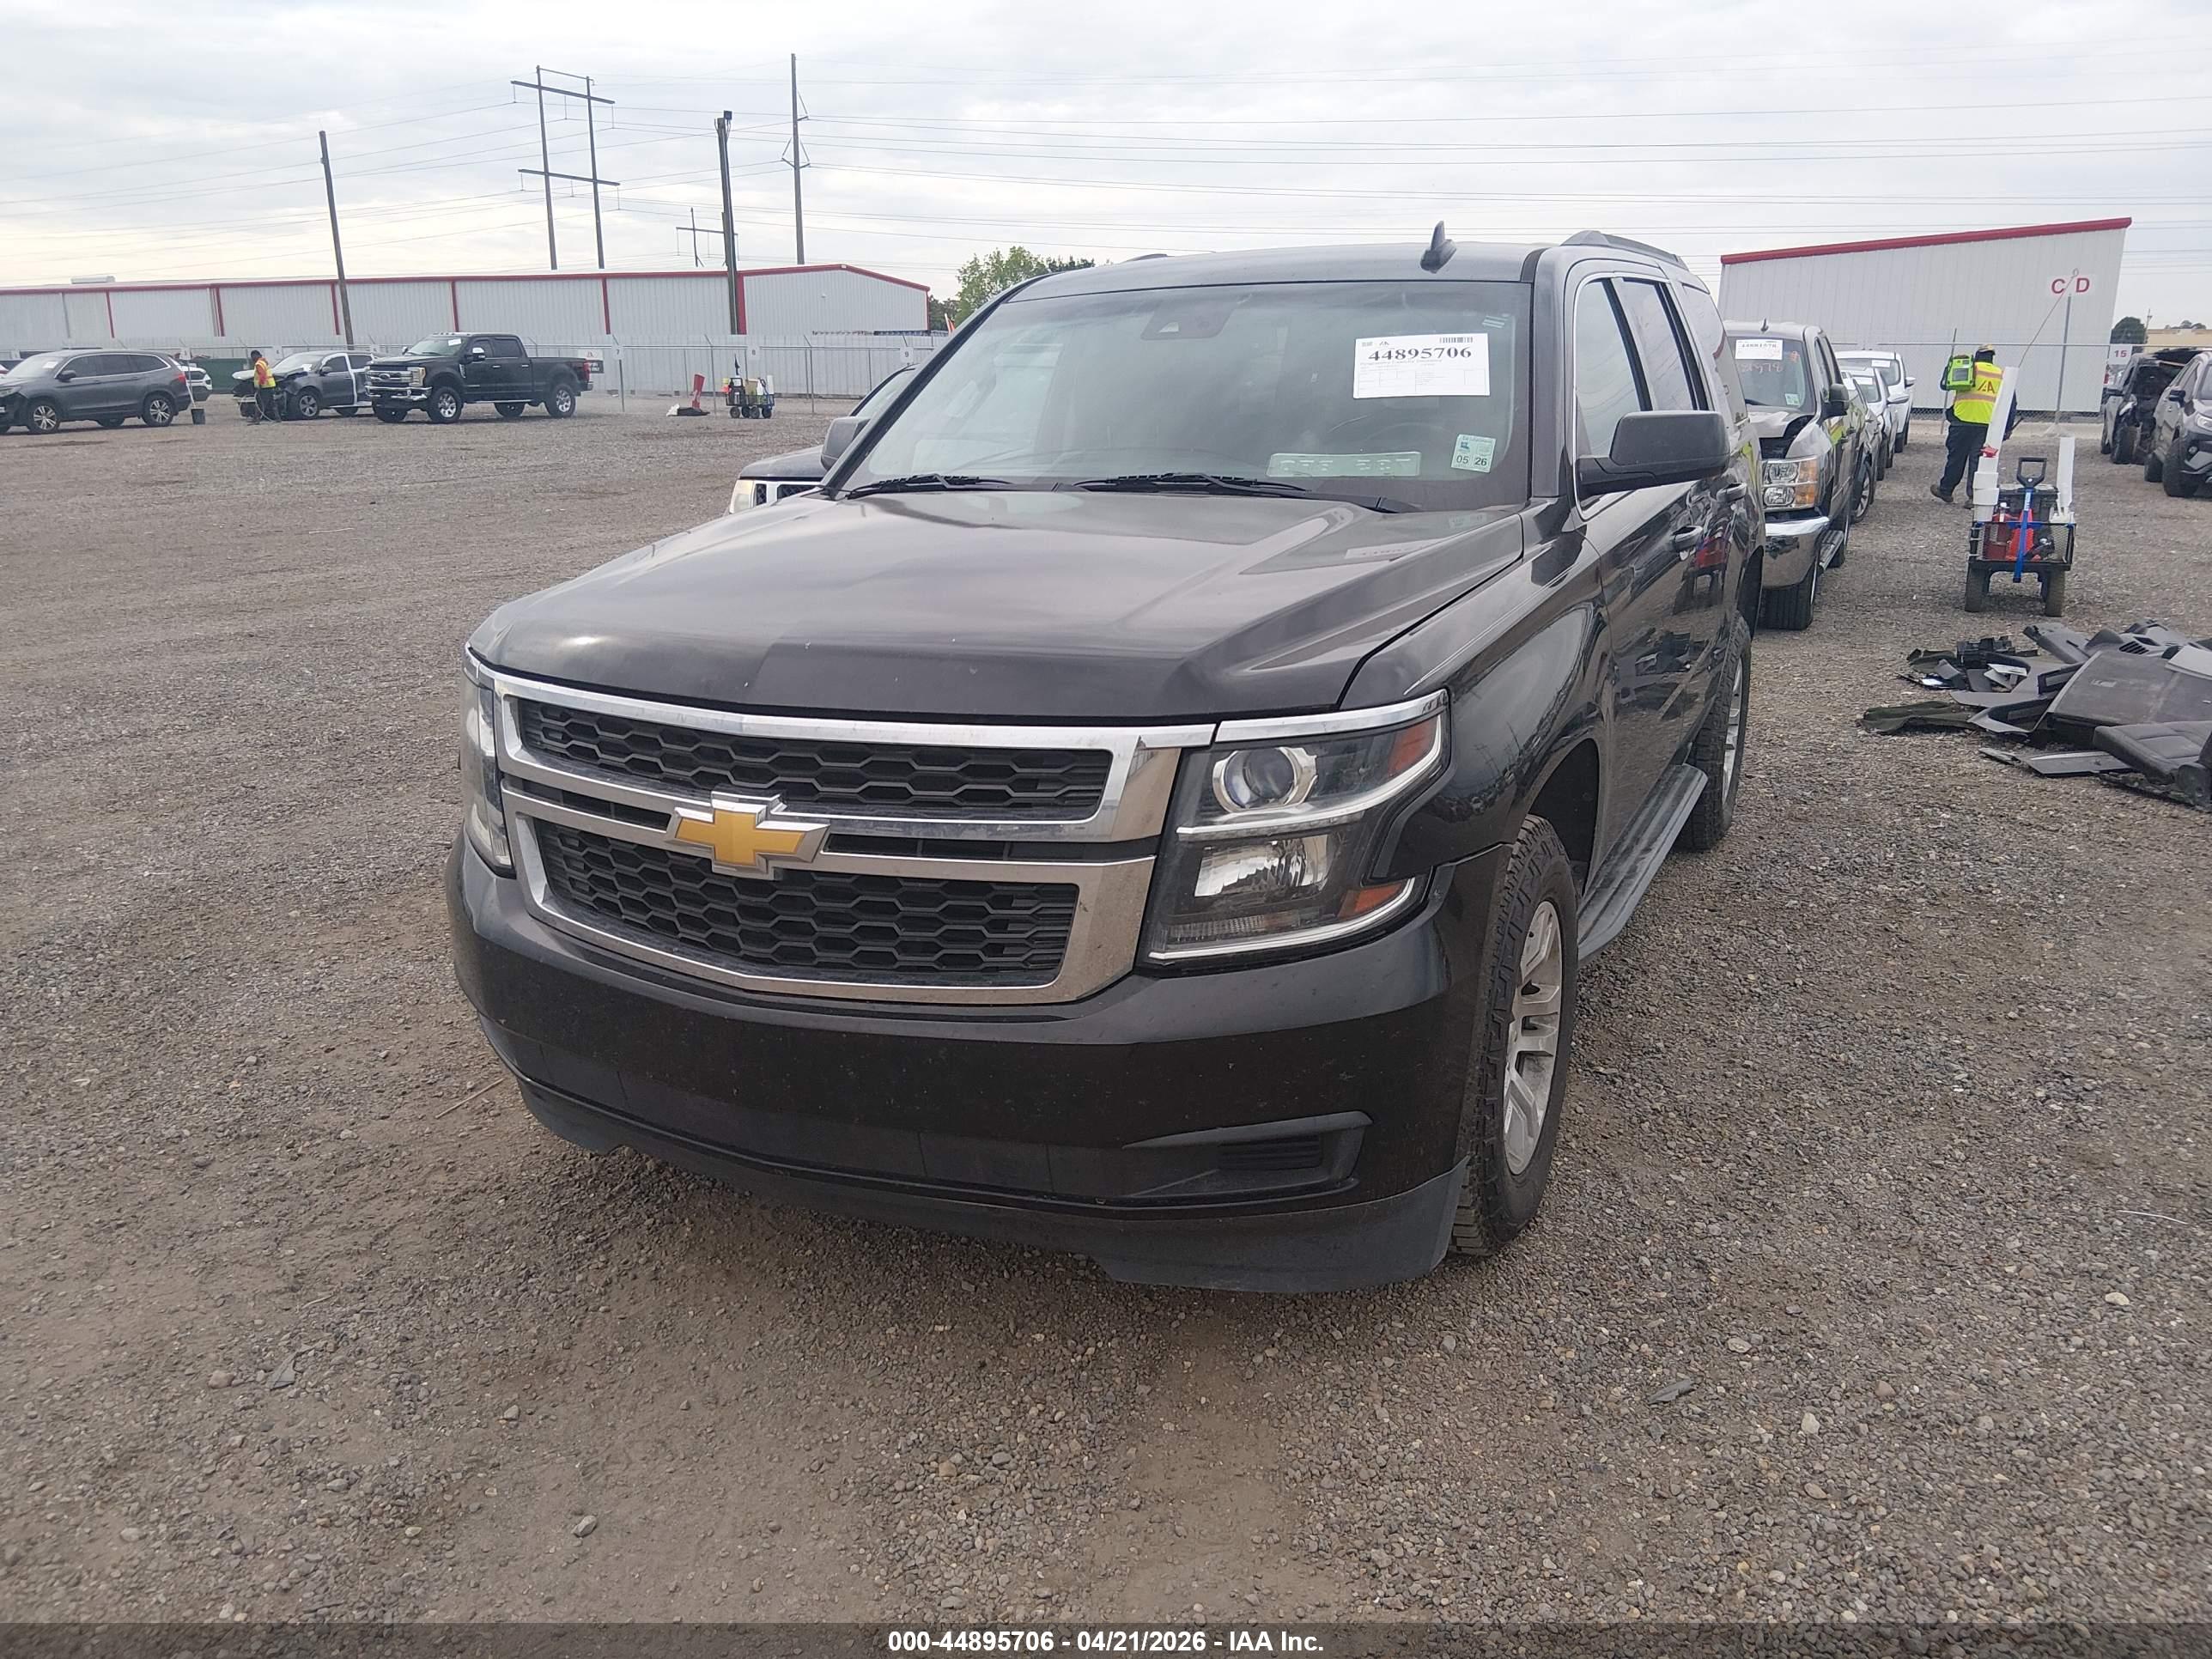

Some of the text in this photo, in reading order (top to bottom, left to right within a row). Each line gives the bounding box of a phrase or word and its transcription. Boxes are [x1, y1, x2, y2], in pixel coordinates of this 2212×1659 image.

[2051, 277, 2090, 294] C D
[1368, 347, 1472, 361] 44895706
[2114, 349, 2128, 358] 15
[1456, 454, 1487, 466] 05 26
